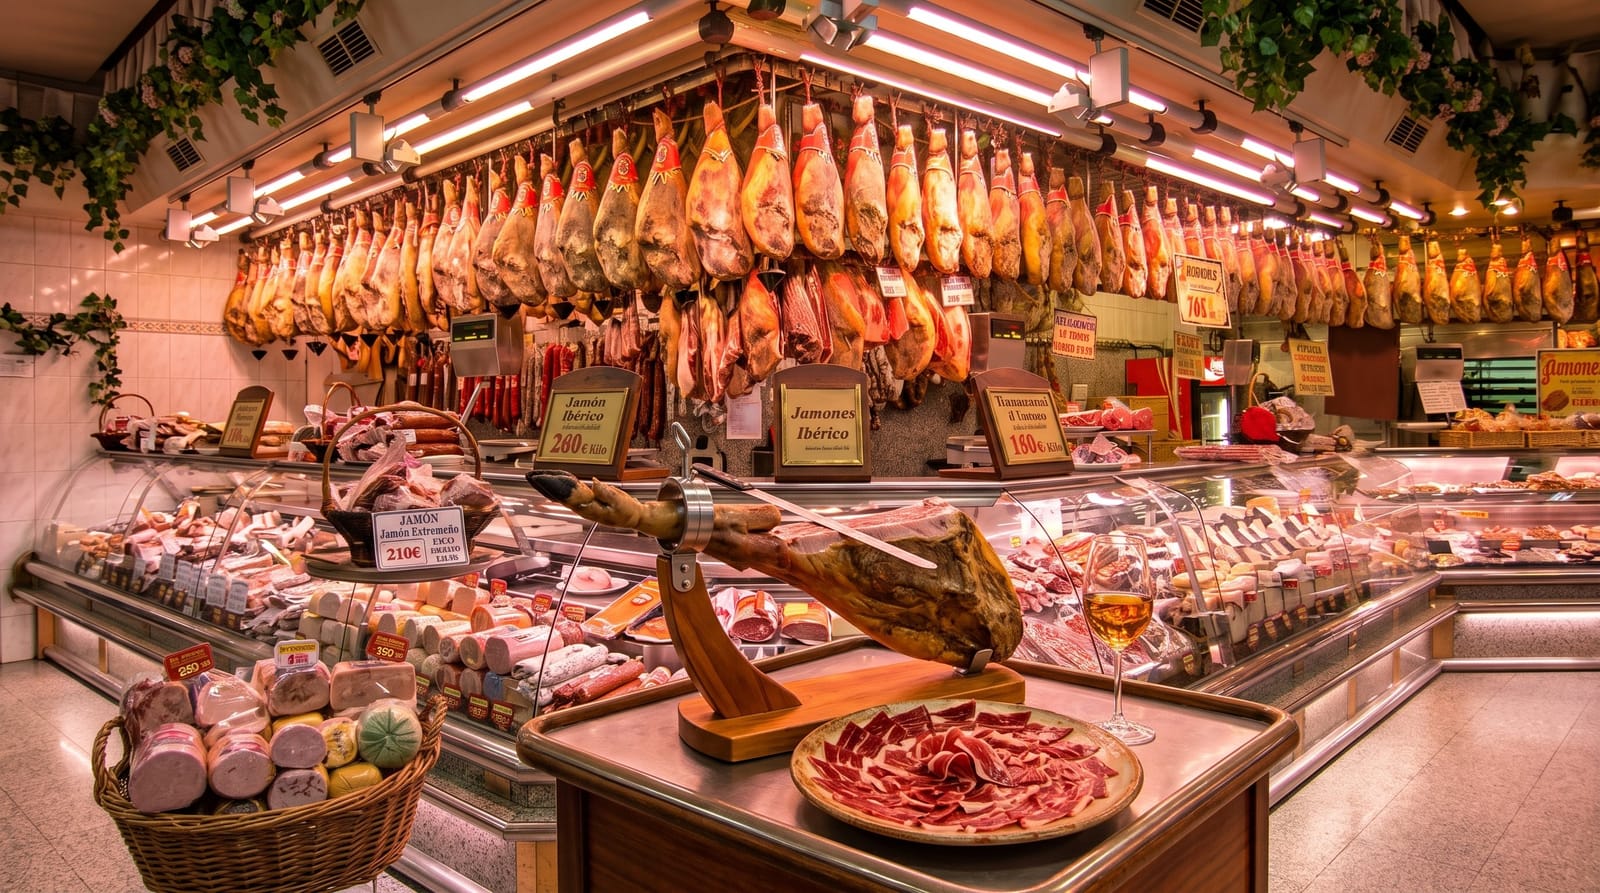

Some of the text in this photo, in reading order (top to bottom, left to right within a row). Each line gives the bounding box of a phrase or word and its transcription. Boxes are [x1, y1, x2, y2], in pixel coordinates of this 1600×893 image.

[565, 396, 606, 408] Jamón
[562, 410, 604, 421] Ibérico
[790, 406, 856, 420] Jamones
[796, 426, 849, 440] Ibérico
[589, 443, 607, 455] Kilo
[399, 511, 439, 526] JAMÓN
[380, 524, 459, 539] Jamón Extremeño
[386, 546, 422, 561] 210€
[178, 662, 200, 677] 250
